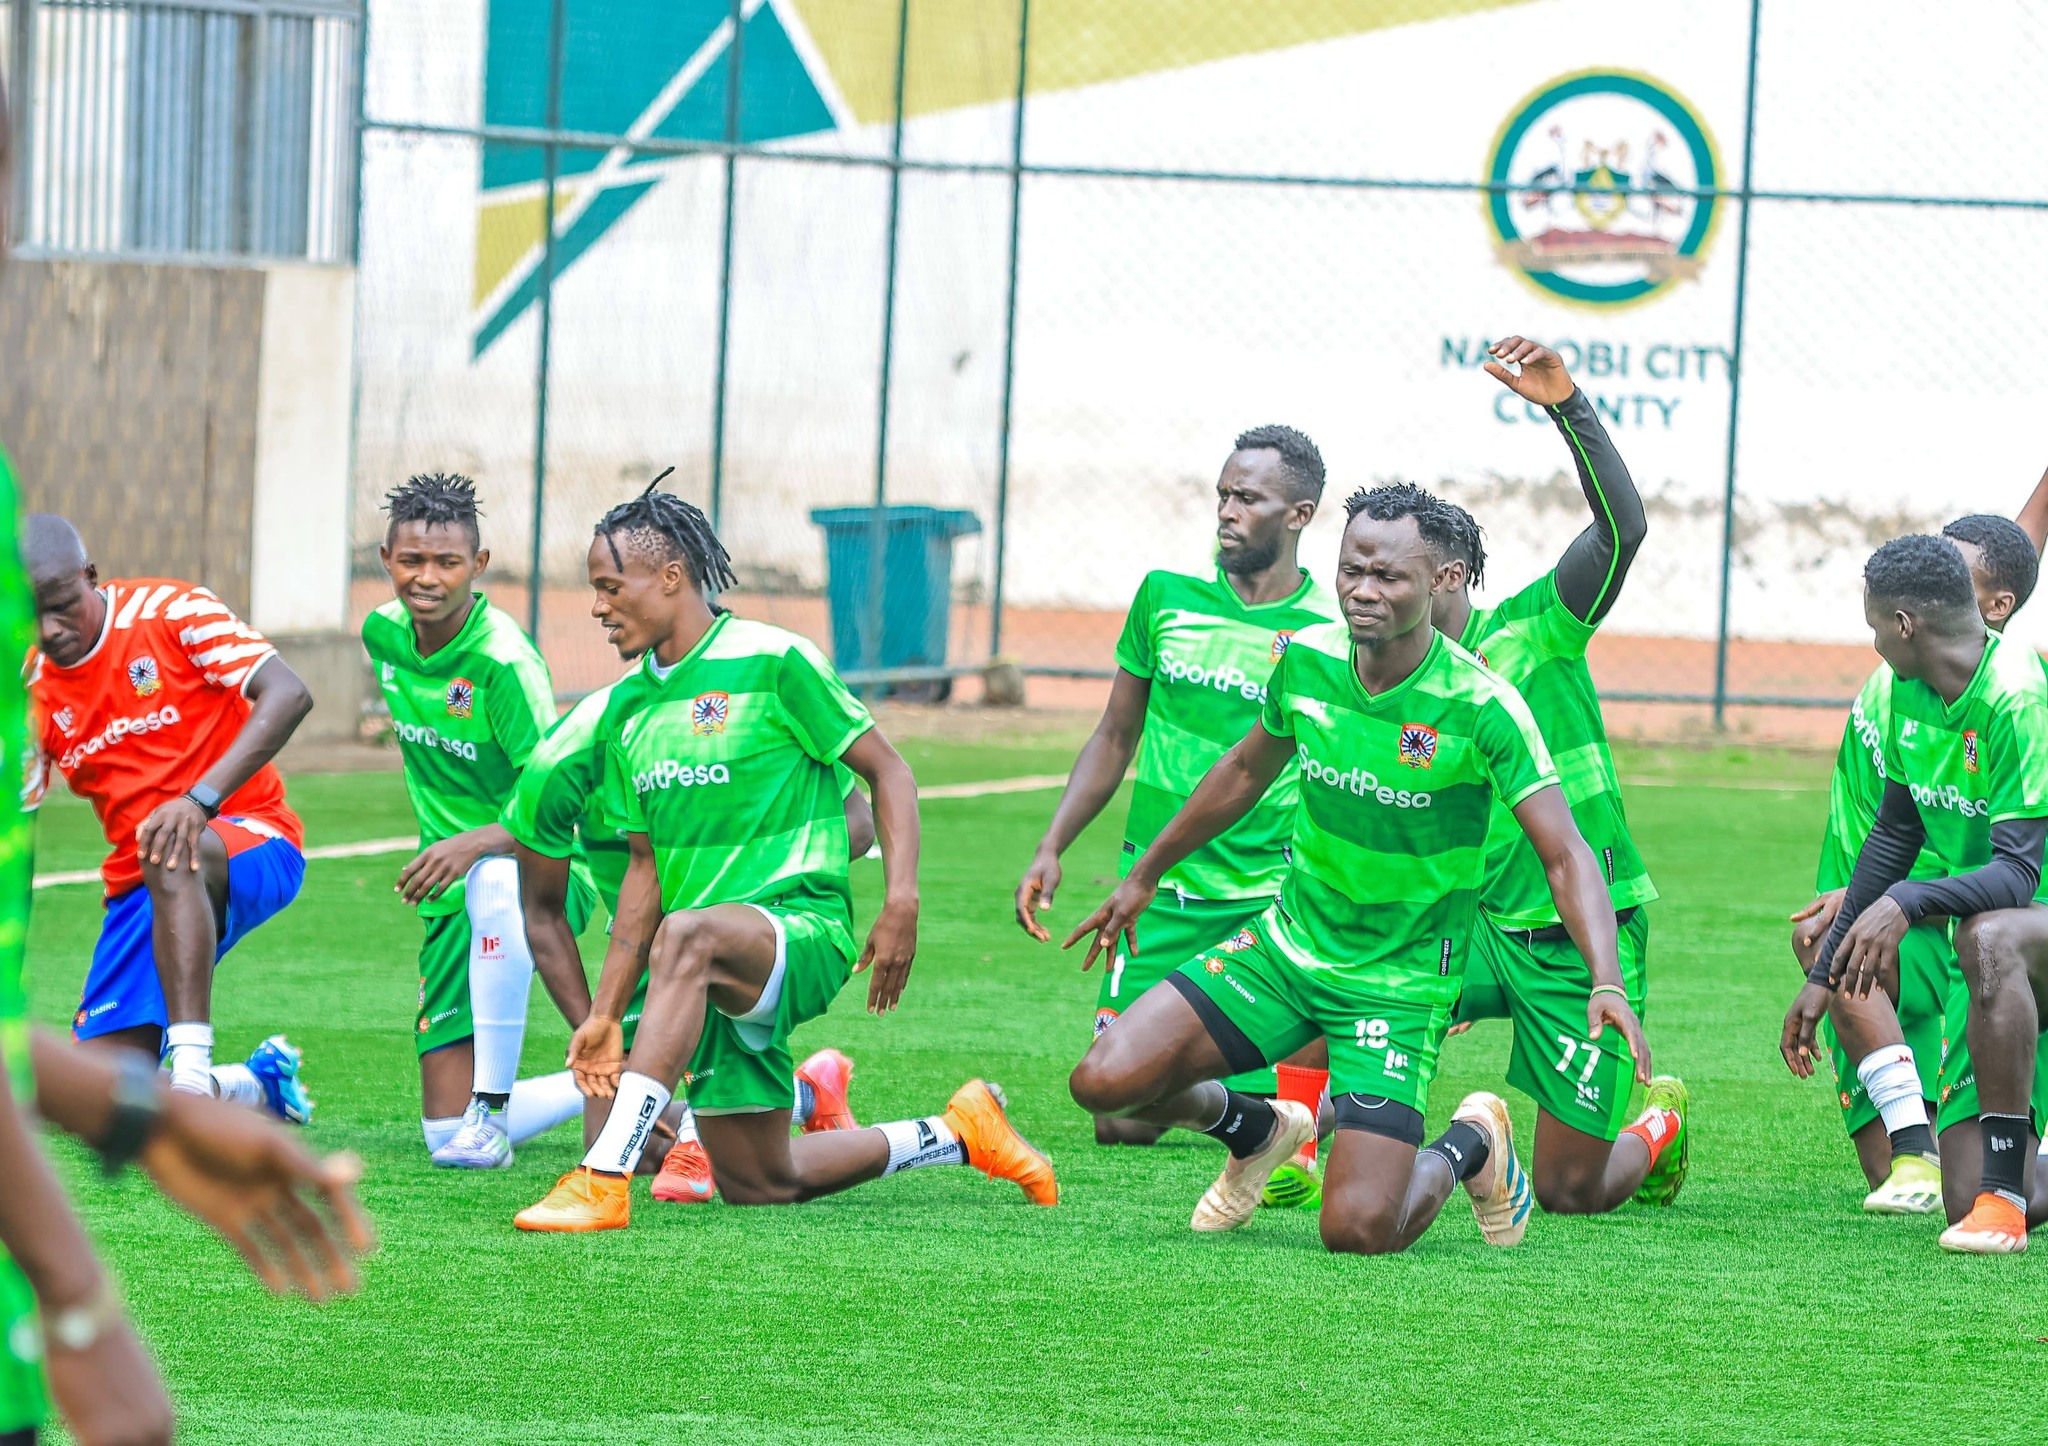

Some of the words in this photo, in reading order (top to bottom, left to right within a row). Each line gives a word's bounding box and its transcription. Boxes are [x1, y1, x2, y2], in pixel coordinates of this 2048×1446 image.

[1441, 335, 1628, 378] NAOBI
[1494, 388, 1681, 427] CONTY
[1159, 648, 1268, 706] SportPes
[59, 704, 181, 769] SportPesa
[394, 720, 477, 762] portPesa
[631, 759, 730, 795] portPesa
[1298, 742, 1432, 809] SportPesa
[1906, 782, 1989, 818] portPesa
[1225, 974, 1256, 1004] CASINO
[89, 1001, 118, 1017] CASINO
[431, 1008, 459, 1024] CASINO
[1354, 1018, 1390, 1049] 18
[1555, 1034, 1602, 1083] 77
[1953, 1073, 1975, 1091] CASI
